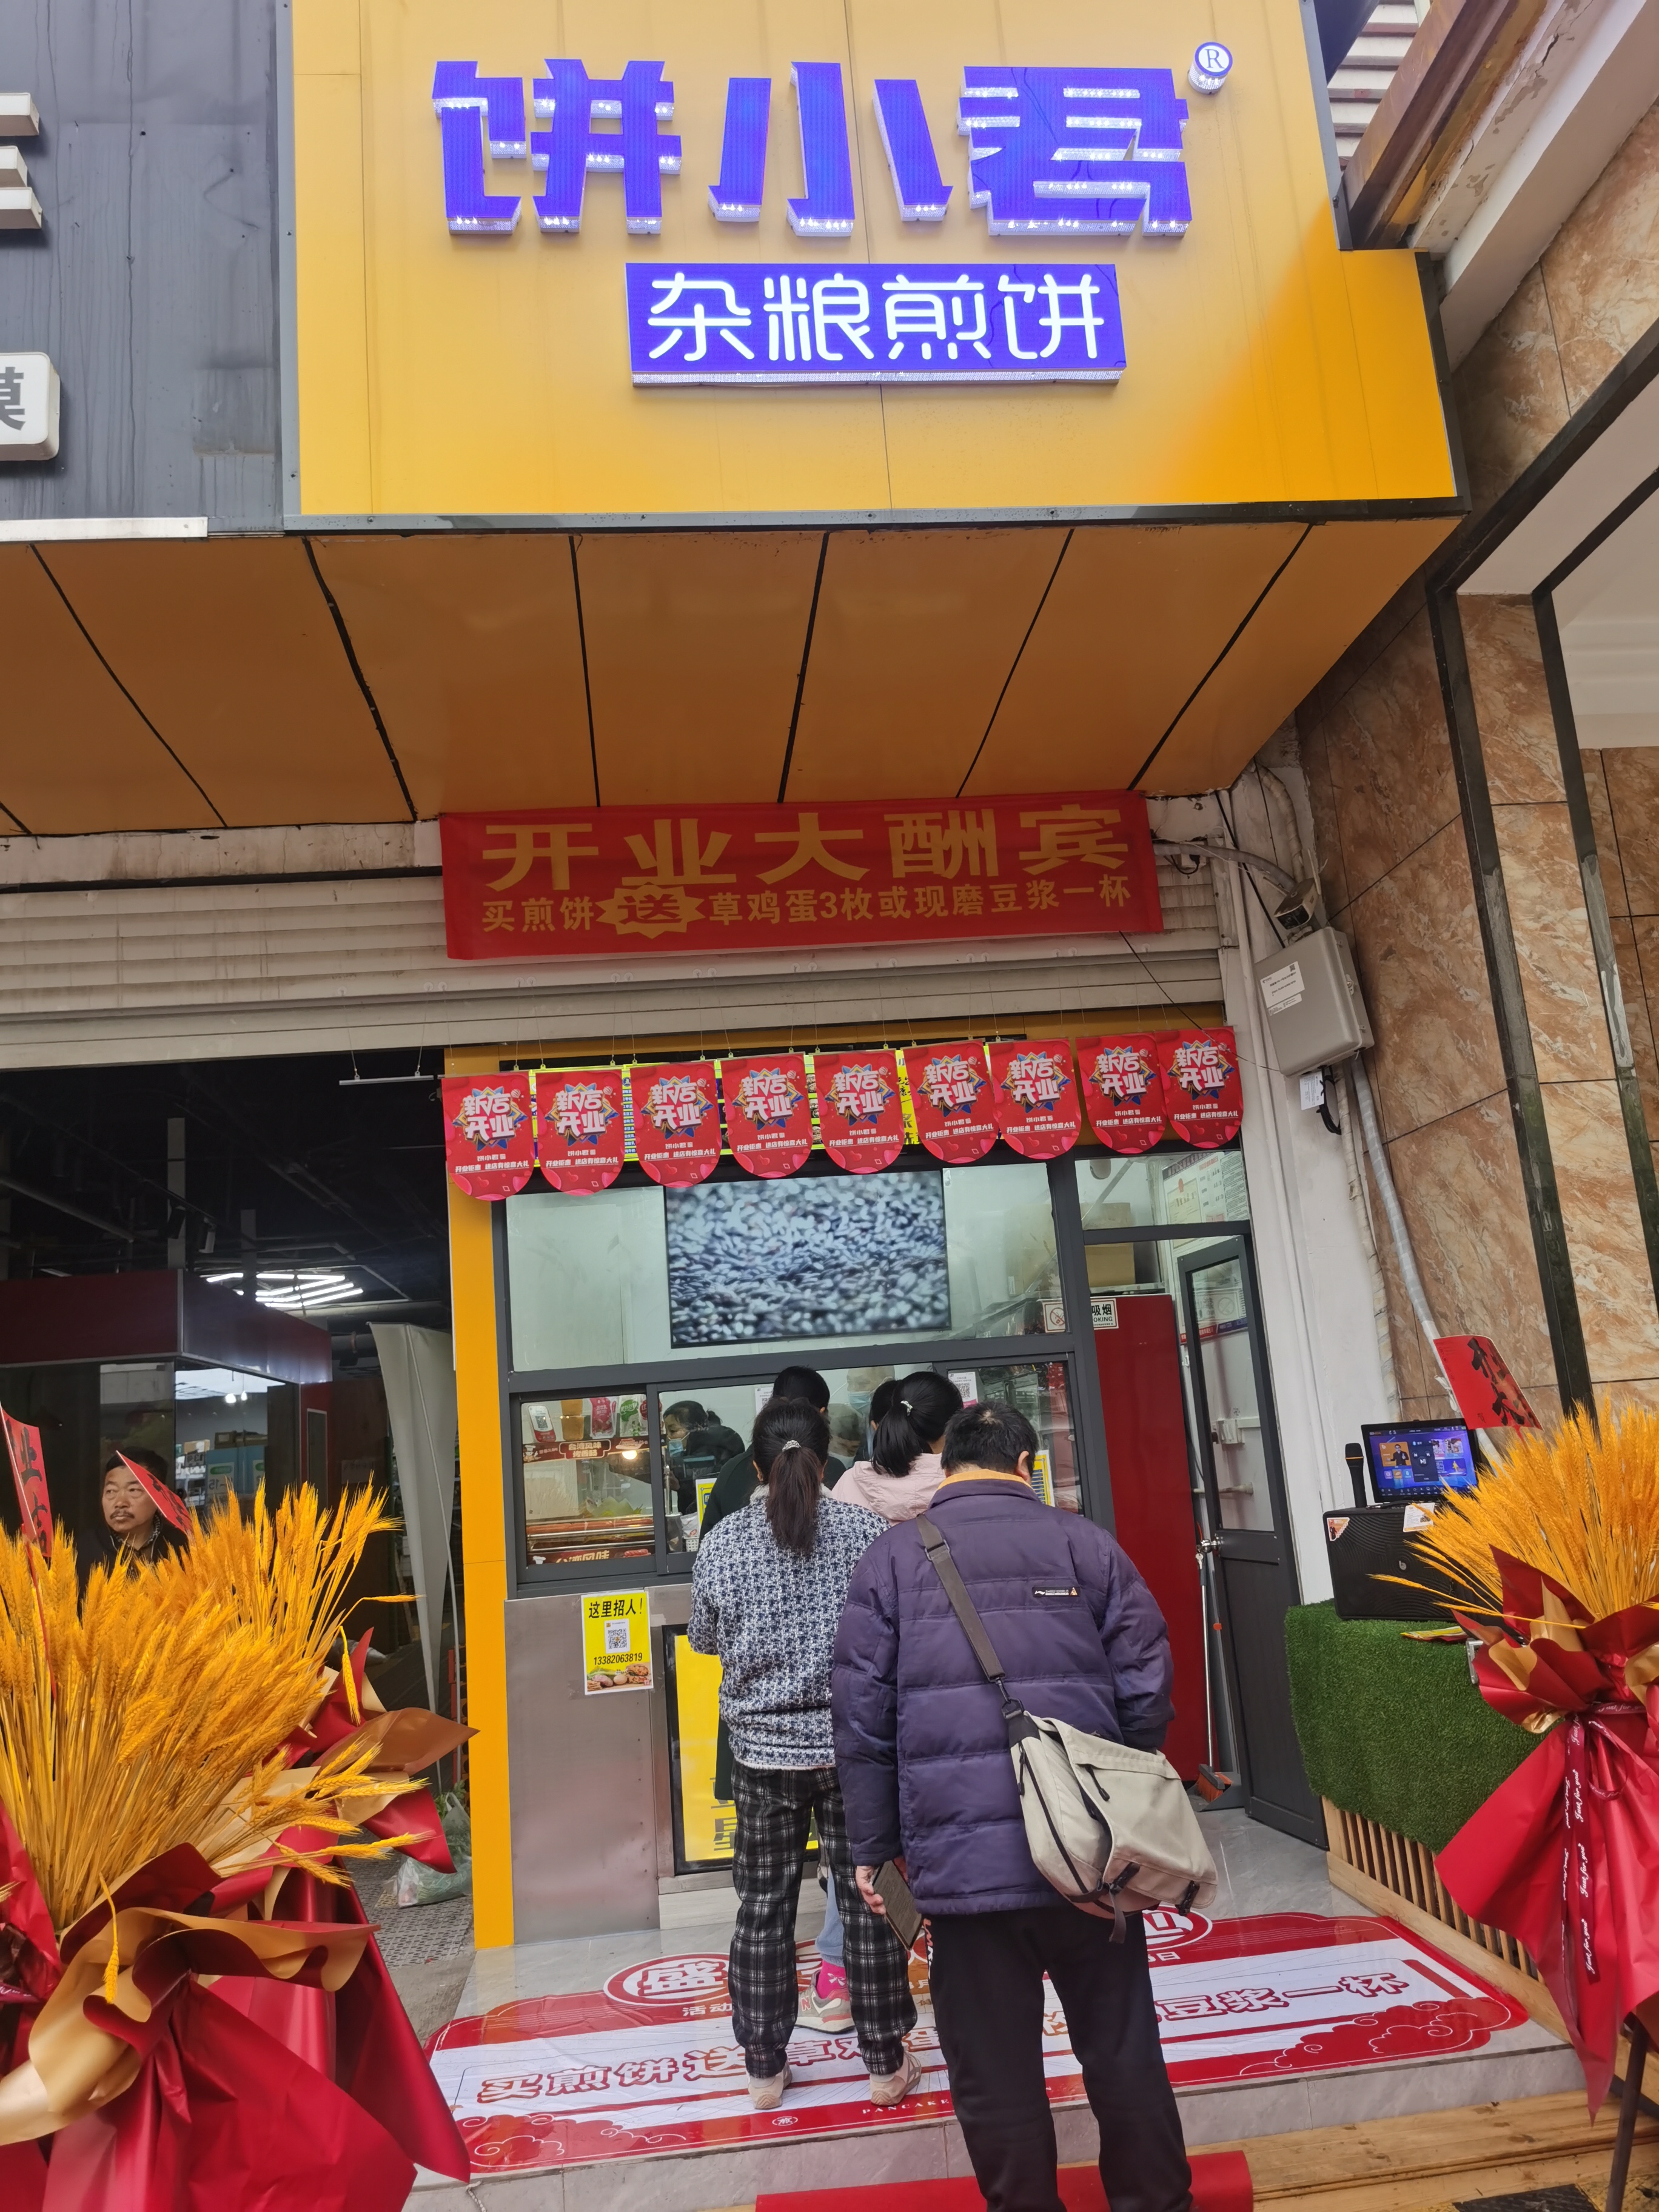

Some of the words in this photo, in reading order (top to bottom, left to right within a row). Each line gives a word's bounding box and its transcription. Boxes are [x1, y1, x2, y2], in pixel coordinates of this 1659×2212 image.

[647, 272, 1105, 362] 杂粮煎饼
[482, 803, 1129, 892] 开业大酬宾
[481, 873, 1131, 934] 买煎饼送草鸡蛋3枚或现磨豆浆一杯
[1010, 1057, 1054, 1079] 新店
[1096, 1052, 1140, 1073] 新店
[1176, 1046, 1219, 1067] 新店
[834, 1070, 880, 1092] 新店
[925, 1060, 970, 1083] 新店
[1179, 1066, 1225, 1091] 开业
[650, 1082, 697, 1105] 新店
[741, 1074, 787, 1097] 新店
[930, 1080, 976, 1107] 开业
[1013, 1078, 1061, 1104] 开业
[1101, 1072, 1147, 1098] 开业
[463, 1093, 511, 1116] 新店
[555, 1089, 603, 1111] 新店
[745, 1094, 792, 1121] 开业
[837, 1090, 884, 1116] 开业
[464, 1114, 515, 1141] 开业
[557, 1110, 606, 1137] 开业
[653, 1102, 702, 1130] 开业
[1092, 1304, 1112, 1316] 吸烟
[568, 1441, 602, 1450] 台湾风味
[594, 1652, 643, 1665] 13382063819
[643, 1961, 725, 1994] 盛
[801, 1997, 811, 2011] N
[477, 2046, 746, 2104] 买煎饼送
[1158, 1972, 1410, 2022] 豆浆一杯
[862, 2099, 950, 2114] PANCAKE
